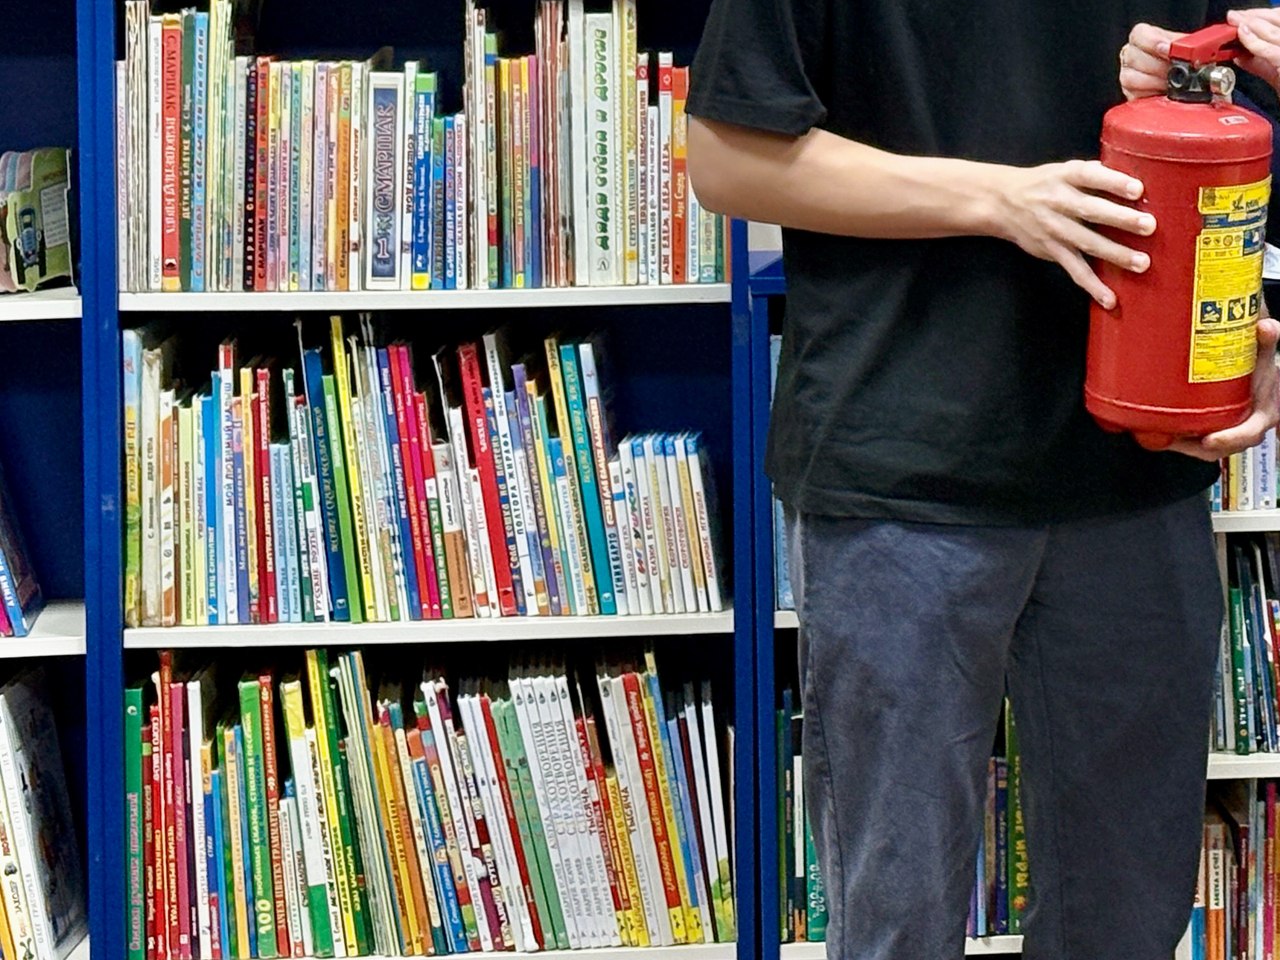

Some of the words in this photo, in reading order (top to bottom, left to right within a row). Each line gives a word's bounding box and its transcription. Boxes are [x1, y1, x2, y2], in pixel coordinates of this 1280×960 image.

[165, 49, 178, 111] МАРШАК
[182, 138, 191, 176] КЛЕТКЕ
[405, 134, 414, 185] КОШКИН
[182, 188, 191, 220] ДЕТКИ
[405, 188, 414, 214] ДОМ
[502, 433, 516, 479] ЖИРАФА
[510, 485, 524, 535] ПОЛТОРА
[695, 491, 707, 532] ИГРУШКИ
[608, 532, 620, 561] БАРТО
[663, 506, 677, 568] СКОРОГОВОРКИ
[675, 506, 688, 569] СКОРОГОВОРКИ
[701, 535, 714, 579] ЛЮБИМЫЕ
[613, 564, 625, 594] АГНИЯ
[532, 721, 566, 835] СТРАХОТВОРЕНИЯ
[543, 721, 576, 835] СТРАХОТВОРЕНИЯ
[554, 719, 585, 833] СТРАХОТВОРЕНИЯ
[580, 788, 597, 835] ТЫСЯЧА
[608, 783, 624, 819] СТИХАХ
[621, 786, 637, 835] ТЫСЯЧА
[269, 797, 282, 859] ГРАММАТИКА
[619, 832, 638, 891] УМНОЖЕНИЯ
[257, 899, 271, 935] 100
[276, 901, 286, 929] ЗАЧЕМ
[632, 893, 645, 932] ТАБЛИЦА
